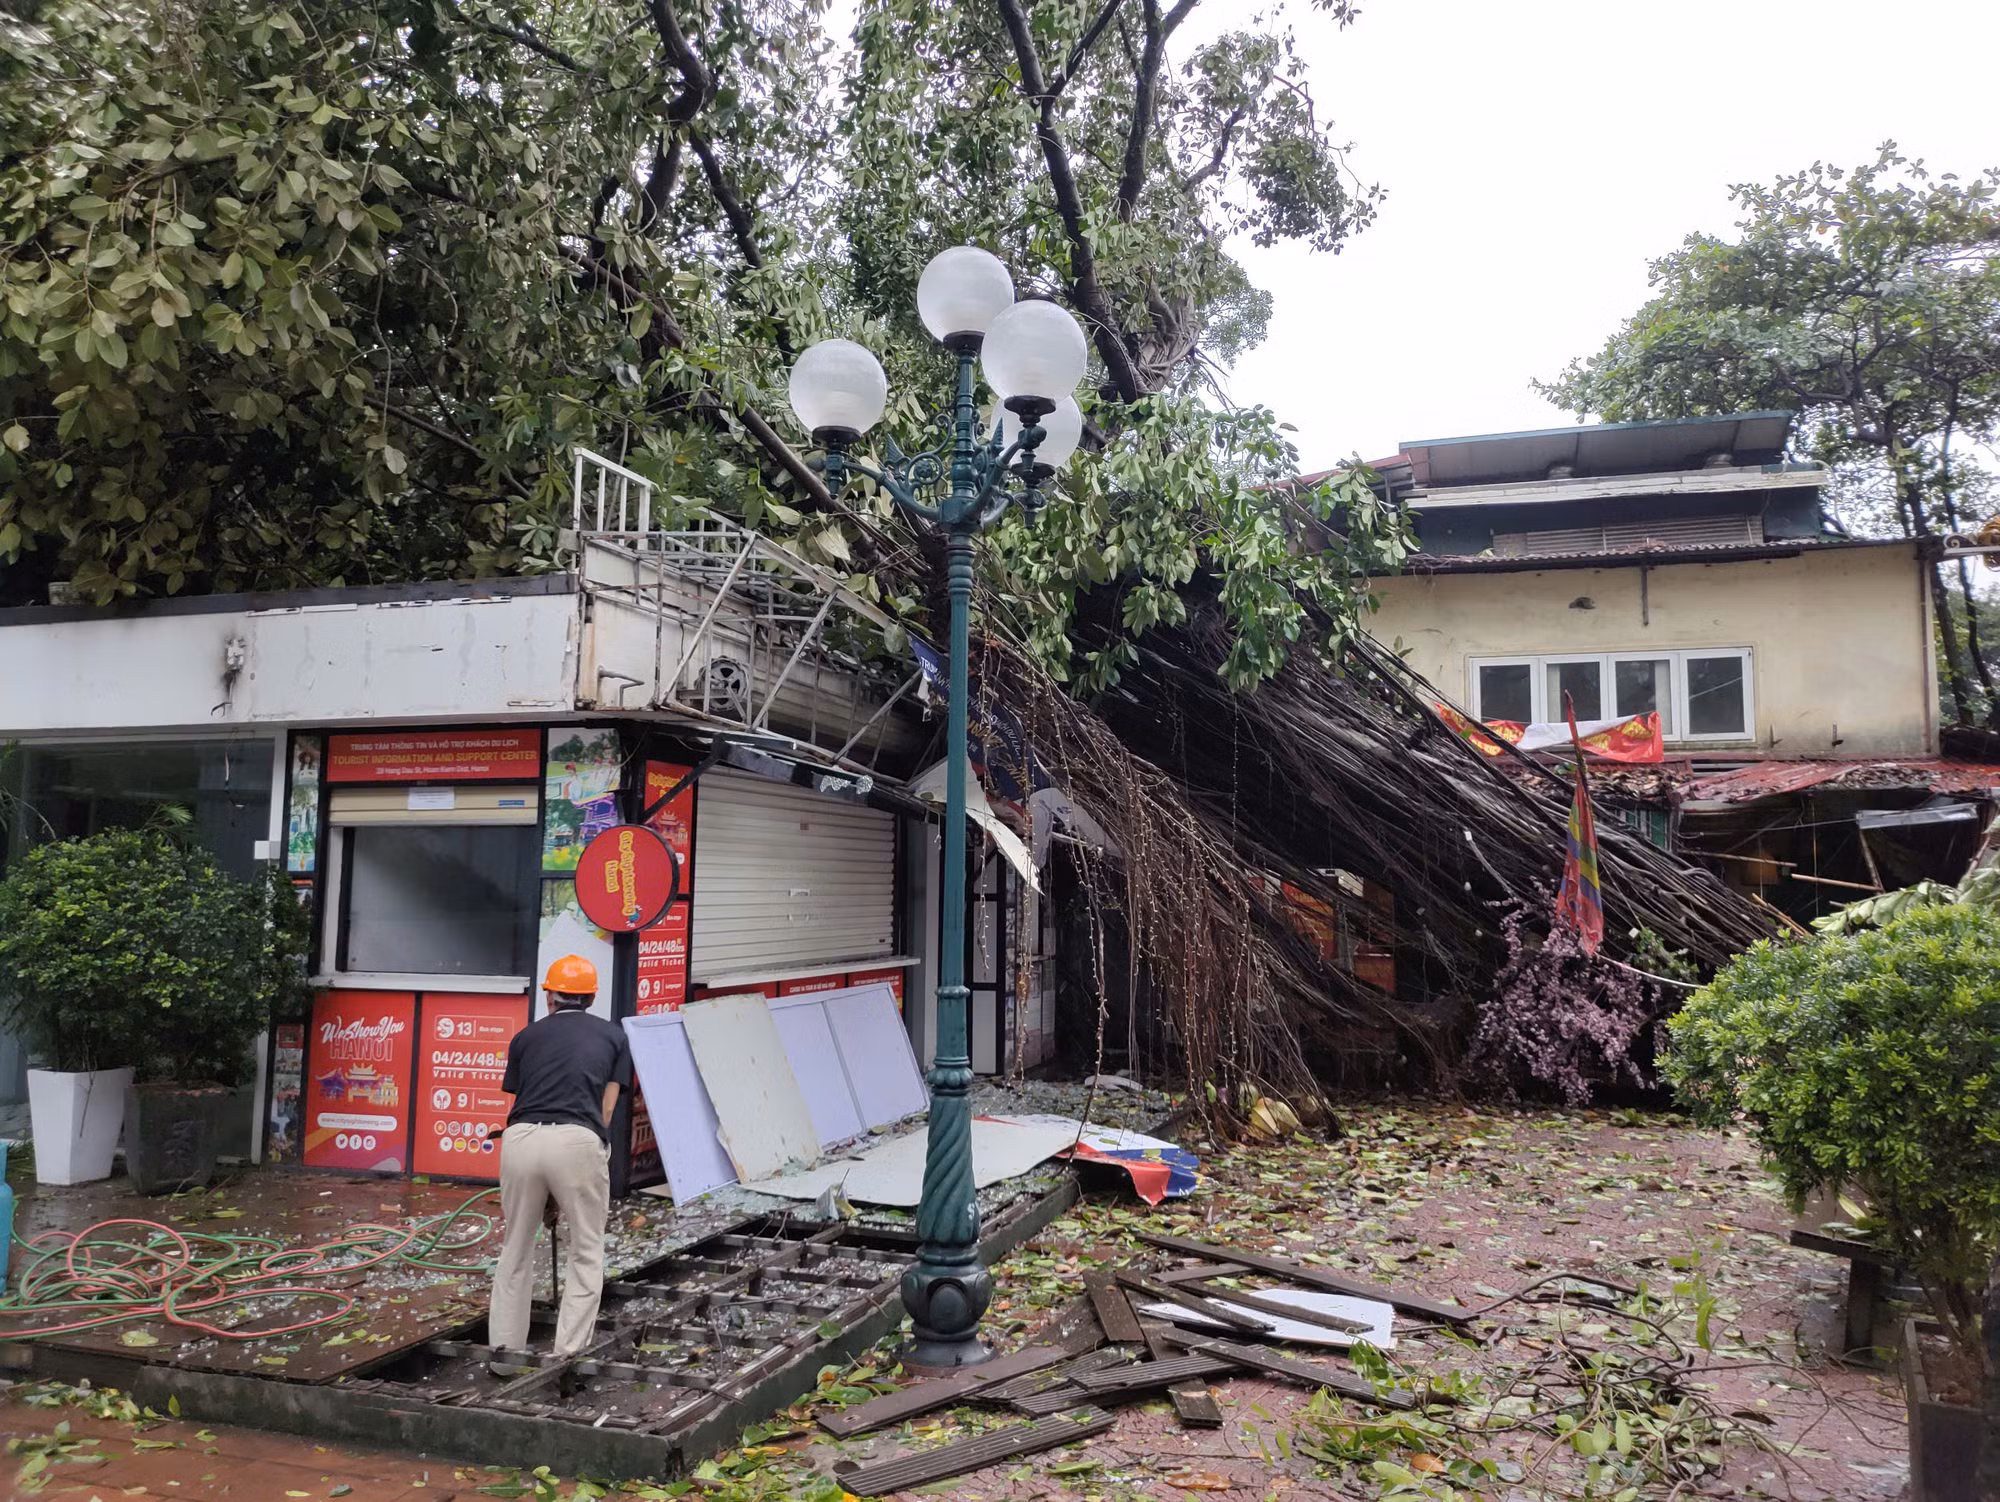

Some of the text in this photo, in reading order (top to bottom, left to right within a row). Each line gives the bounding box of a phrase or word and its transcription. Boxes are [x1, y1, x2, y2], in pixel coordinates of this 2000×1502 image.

[333, 750, 538, 765] TOURIST INFORMATION AND SUPPORT CENTER
[605, 860, 619, 893] Hanoi
[662, 958, 685, 967] Ticket
[653, 980, 660, 995] 9
[457, 1021, 472, 1036] 13
[331, 1038, 394, 1062] HANOI
[433, 1069, 464, 1079] Valid
[458, 1093, 468, 1108] 9
